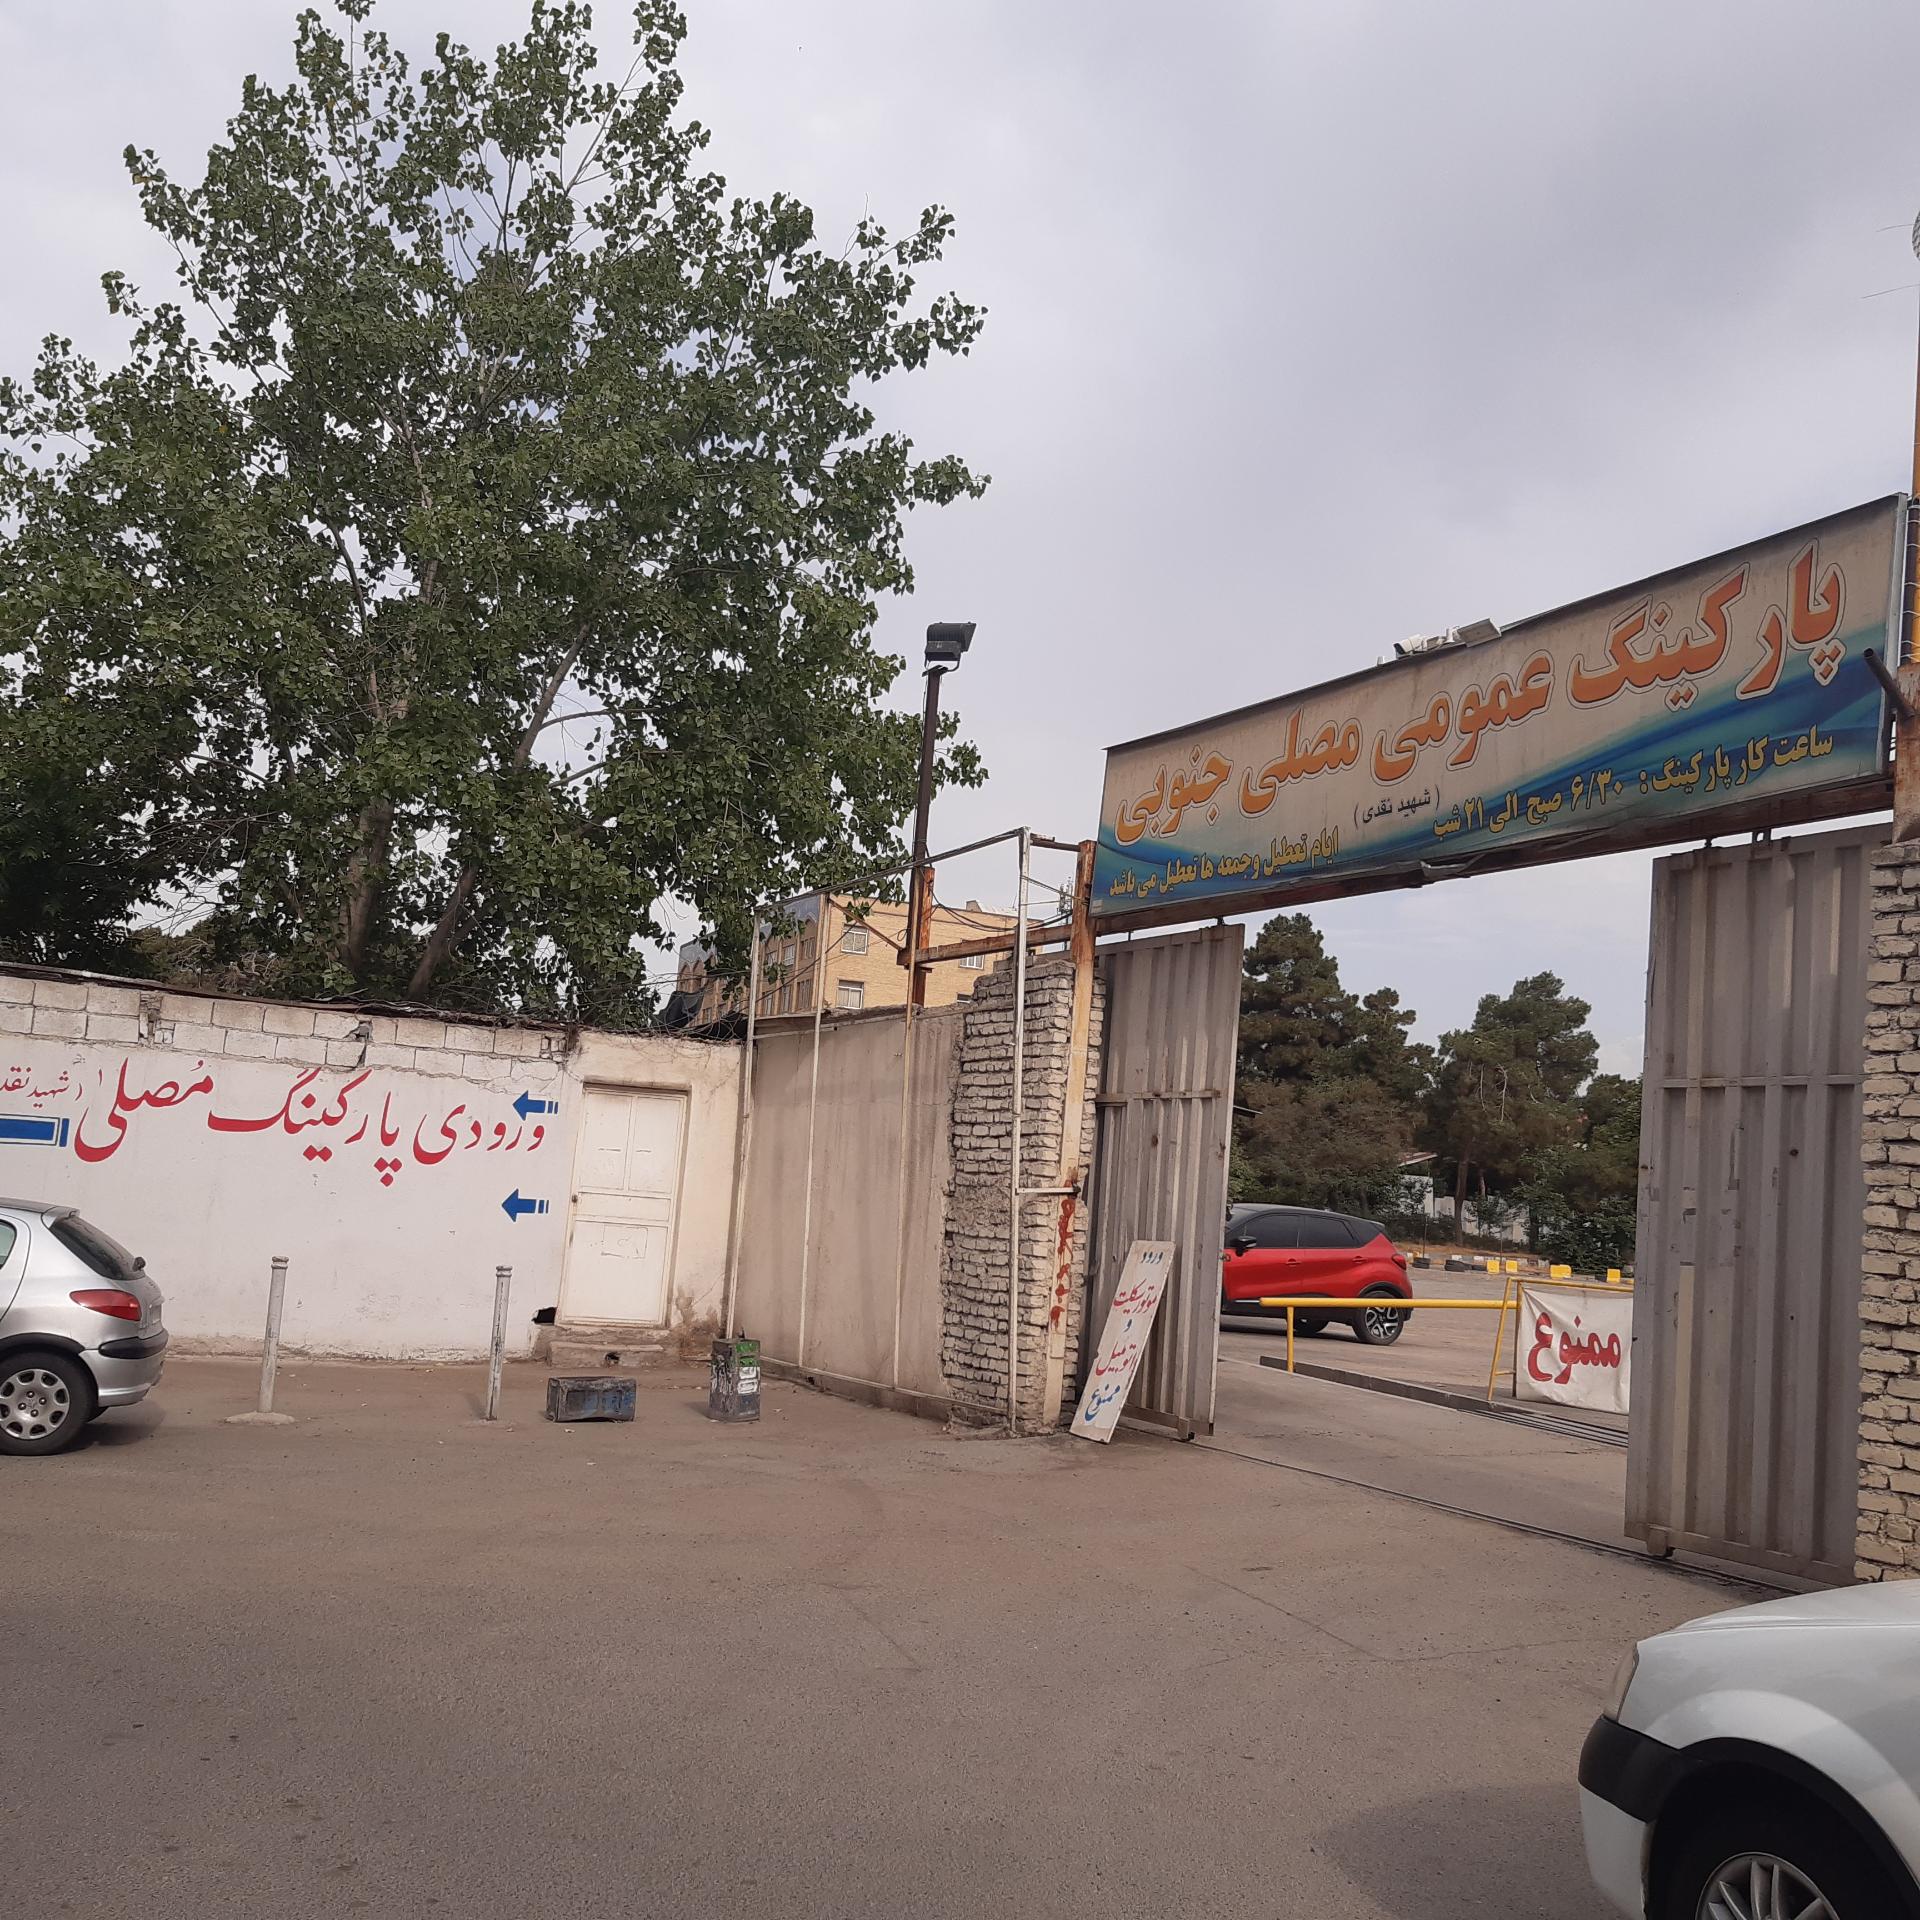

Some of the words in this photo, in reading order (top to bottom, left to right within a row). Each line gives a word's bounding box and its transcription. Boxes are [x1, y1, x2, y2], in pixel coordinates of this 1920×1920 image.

[1569, 541, 1843, 708] پارکینگ
[1373, 652, 1553, 783] عمومی
[1240, 706, 1360, 815] مصلی
[1736, 736, 1768, 785] کار
[1774, 725, 1833, 766] ساعت
[1116, 747, 1231, 843] جنوبی
[1489, 790, 1518, 833] الی
[1526, 791, 1562, 825] صبح
[1433, 804, 1461, 840] شب
[1218, 853, 1252, 880] جمعه
[1263, 834, 1307, 876] تعطیل
[1311, 825, 1339, 867] ایام
[1109, 868, 1136, 898] باشد
[1137, 873, 1158, 898] می
[1159, 856, 1198, 893] تعطیل
[207, 1067, 403, 1187] پارکینگ
[413, 1104, 546, 1164] ورودی
[1124, 1319, 1132, 1333] و
[1527, 1311, 1621, 1385] ممنوع
[1085, 1383, 1120, 1421] ممنوع
